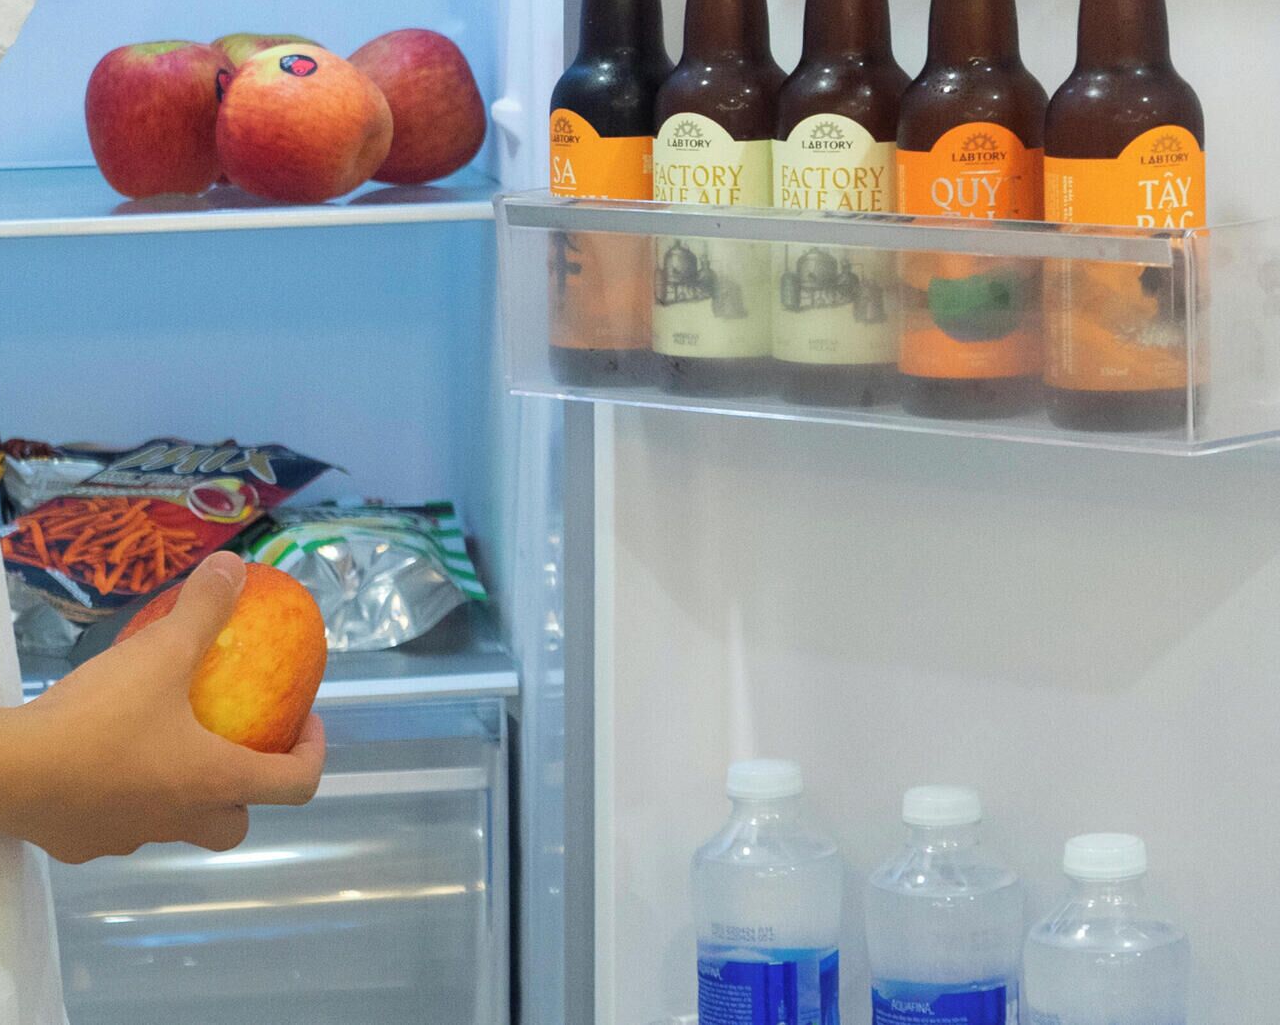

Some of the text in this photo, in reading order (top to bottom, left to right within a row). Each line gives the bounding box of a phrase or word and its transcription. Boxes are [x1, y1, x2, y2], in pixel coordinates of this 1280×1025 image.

[667, 138, 713, 149] LABTORY
[801, 140, 854, 150] LABTORY
[951, 151, 1007, 163] LABTORY
[1140, 152, 1189, 165] LABTORY
[553, 156, 577, 185] SA
[655, 163, 744, 188] FACTORY
[781, 165, 885, 190] FACTORY
[837, 189, 883, 212] ALE
[930, 176, 1004, 211] QUY
[1137, 172, 1192, 210] TÂY
